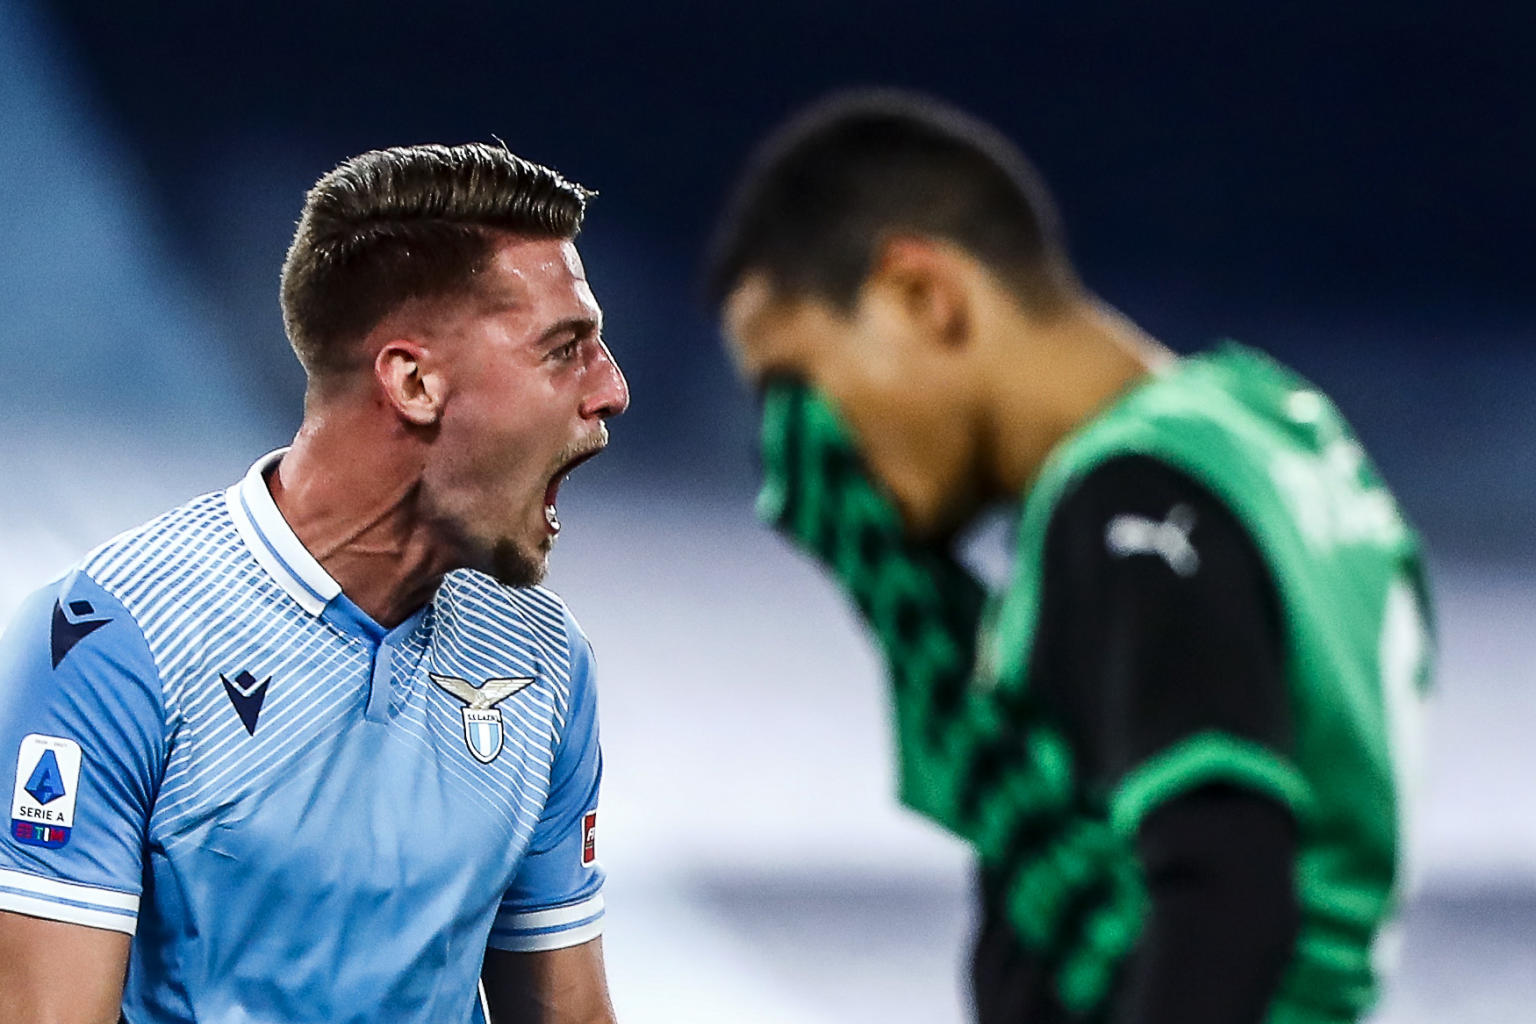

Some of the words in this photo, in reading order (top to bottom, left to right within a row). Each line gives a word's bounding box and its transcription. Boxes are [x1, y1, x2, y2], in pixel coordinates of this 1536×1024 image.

[19, 806, 53, 821] SERIE
[56, 812, 65, 822] A
[34, 826, 66, 843] TIM
